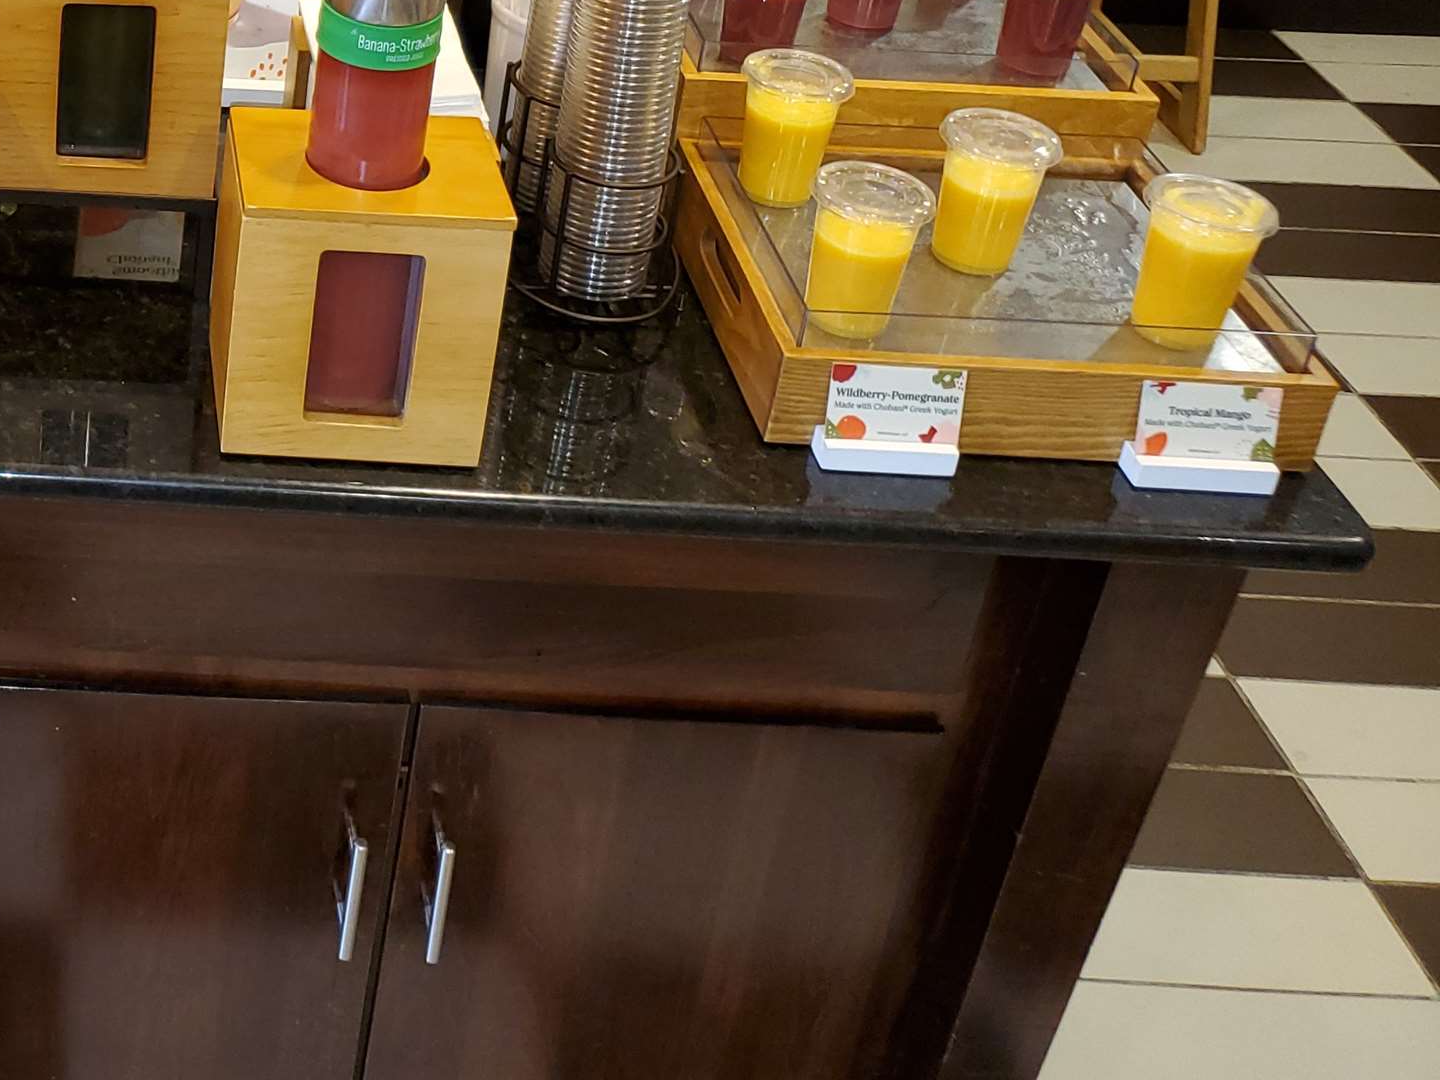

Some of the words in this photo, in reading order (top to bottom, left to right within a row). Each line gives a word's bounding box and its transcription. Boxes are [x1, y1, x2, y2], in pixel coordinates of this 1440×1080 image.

[836, 387, 960, 404] Wildberry-Pomegranate
[835, 400, 854, 409] Made
[909, 406, 931, 414] Greek
[934, 407, 958, 416] Yogurt
[1168, 406, 1212, 418] Tropical
[1214, 408, 1252, 420] Mango
